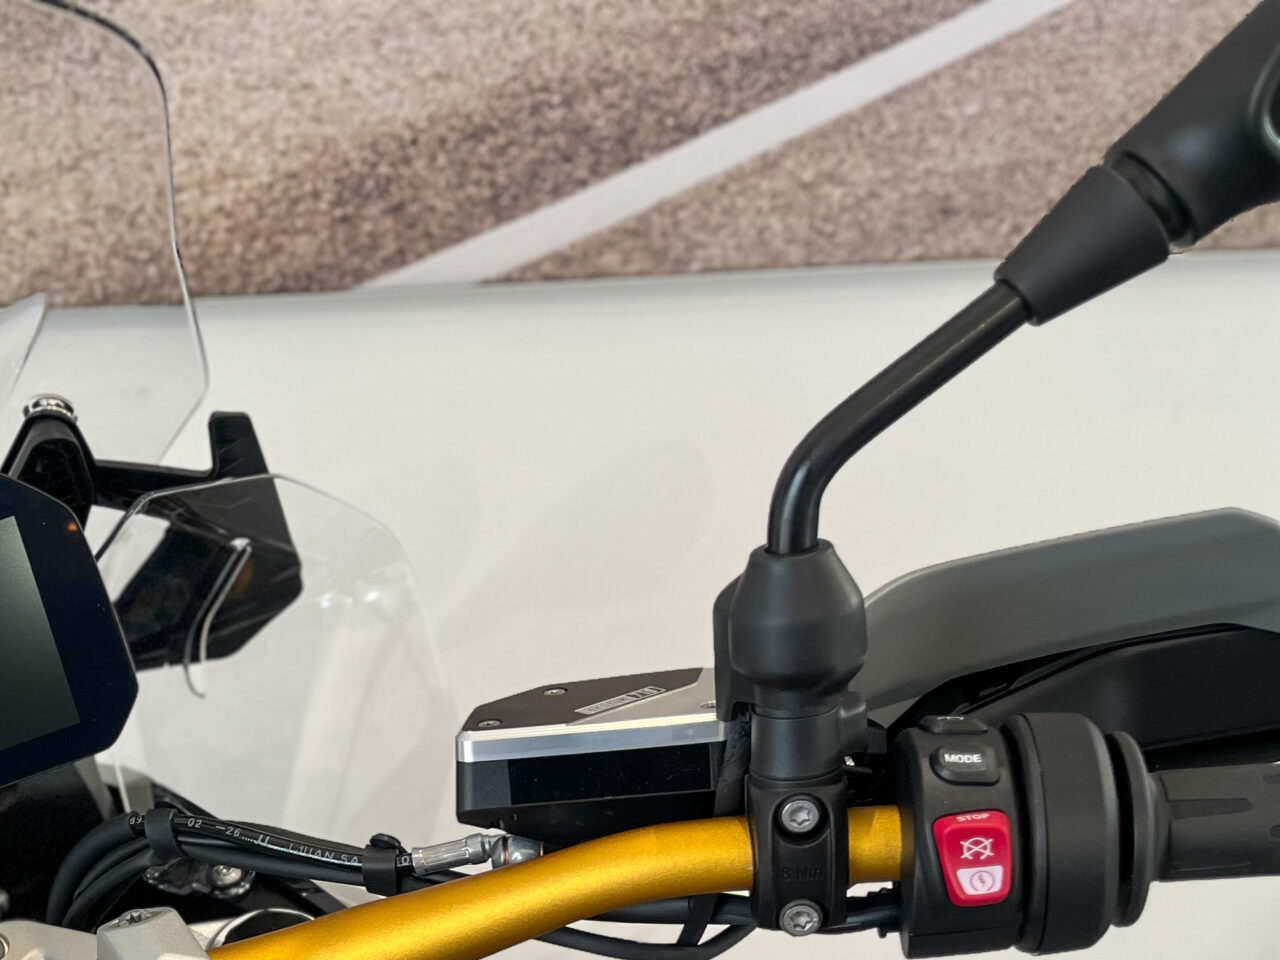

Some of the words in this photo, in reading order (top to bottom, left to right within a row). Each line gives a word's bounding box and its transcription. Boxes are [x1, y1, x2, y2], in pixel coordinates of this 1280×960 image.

[944, 753, 982, 763] MODE
[956, 813, 990, 822] STOP
[187, 818, 202, 829] 02
